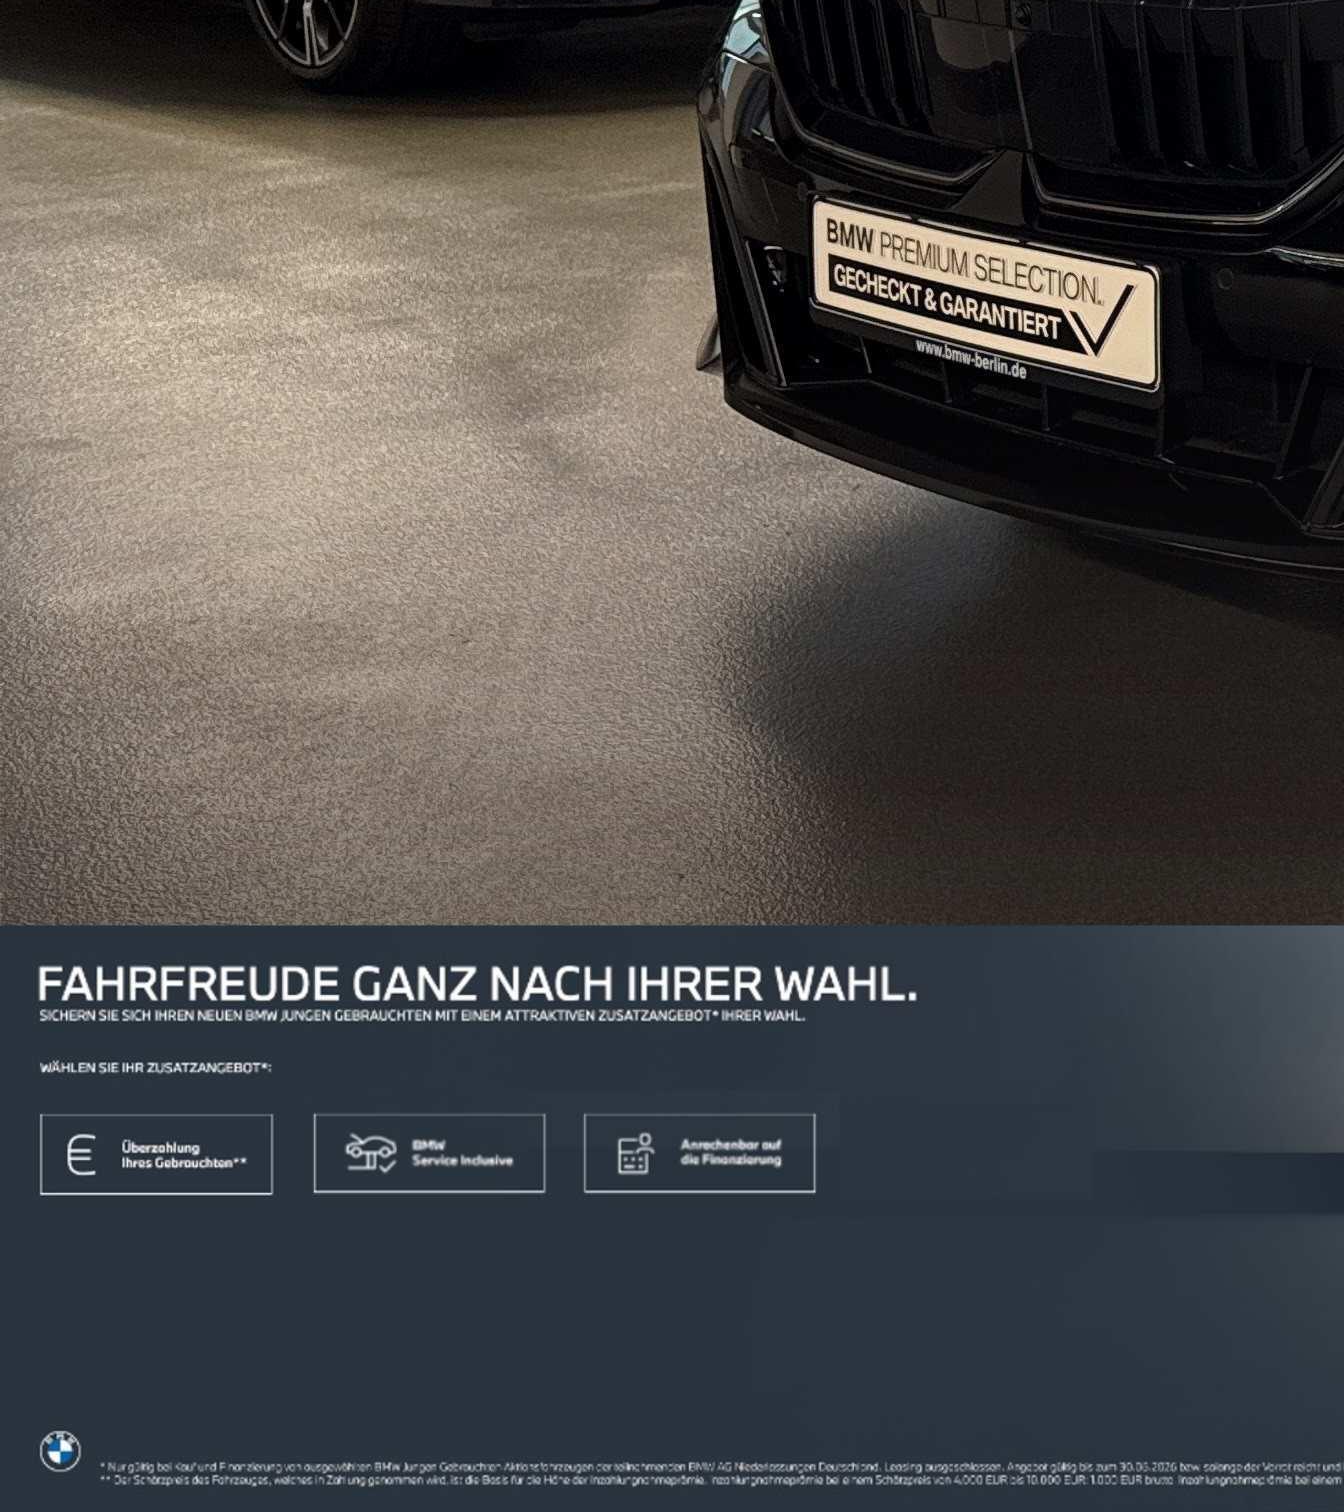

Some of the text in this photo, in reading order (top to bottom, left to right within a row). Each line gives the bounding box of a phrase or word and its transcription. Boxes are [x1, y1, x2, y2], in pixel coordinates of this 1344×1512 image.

[826, 217, 874, 254] BMW
[879, 231, 969, 278] PREMIUM
[833, 263, 1062, 340] GECHECKT & GARANTIERT
[916, 338, 1027, 380] www.bmw-berlin.de
